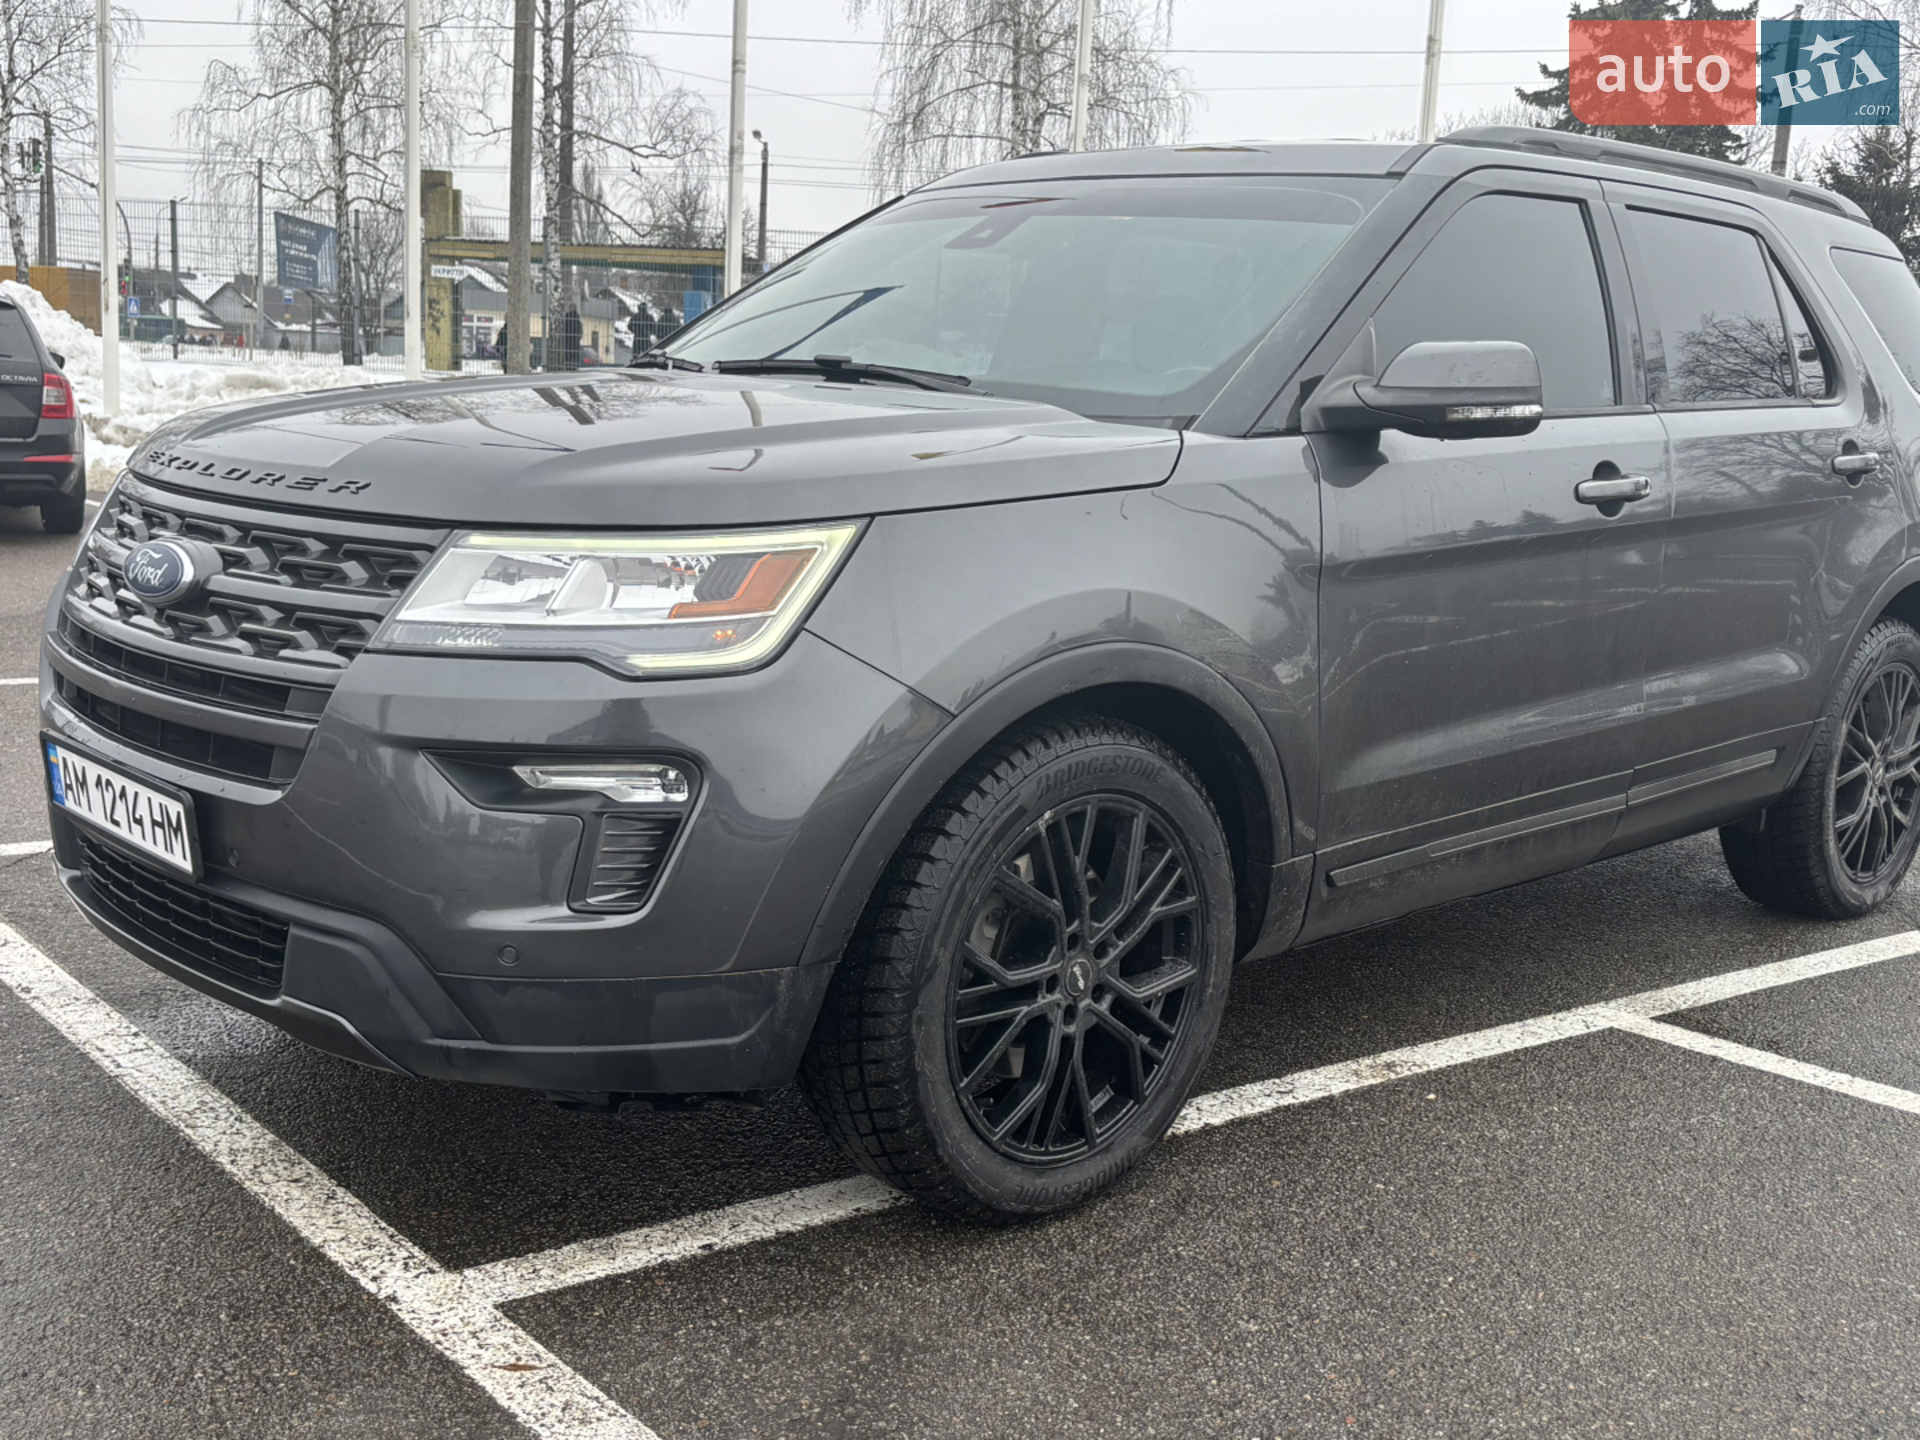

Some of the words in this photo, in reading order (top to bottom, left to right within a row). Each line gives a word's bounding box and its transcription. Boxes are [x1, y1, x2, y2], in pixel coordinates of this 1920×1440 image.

[0, 374, 38, 382] OCTAVIA
[148, 451, 372, 495] EXPLORER
[128, 548, 169, 586] Ford
[1035, 755, 1165, 800] BRIDGESTONE
[62, 756, 93, 814] AM
[95, 773, 146, 841] 1214
[148, 796, 188, 862] HM
